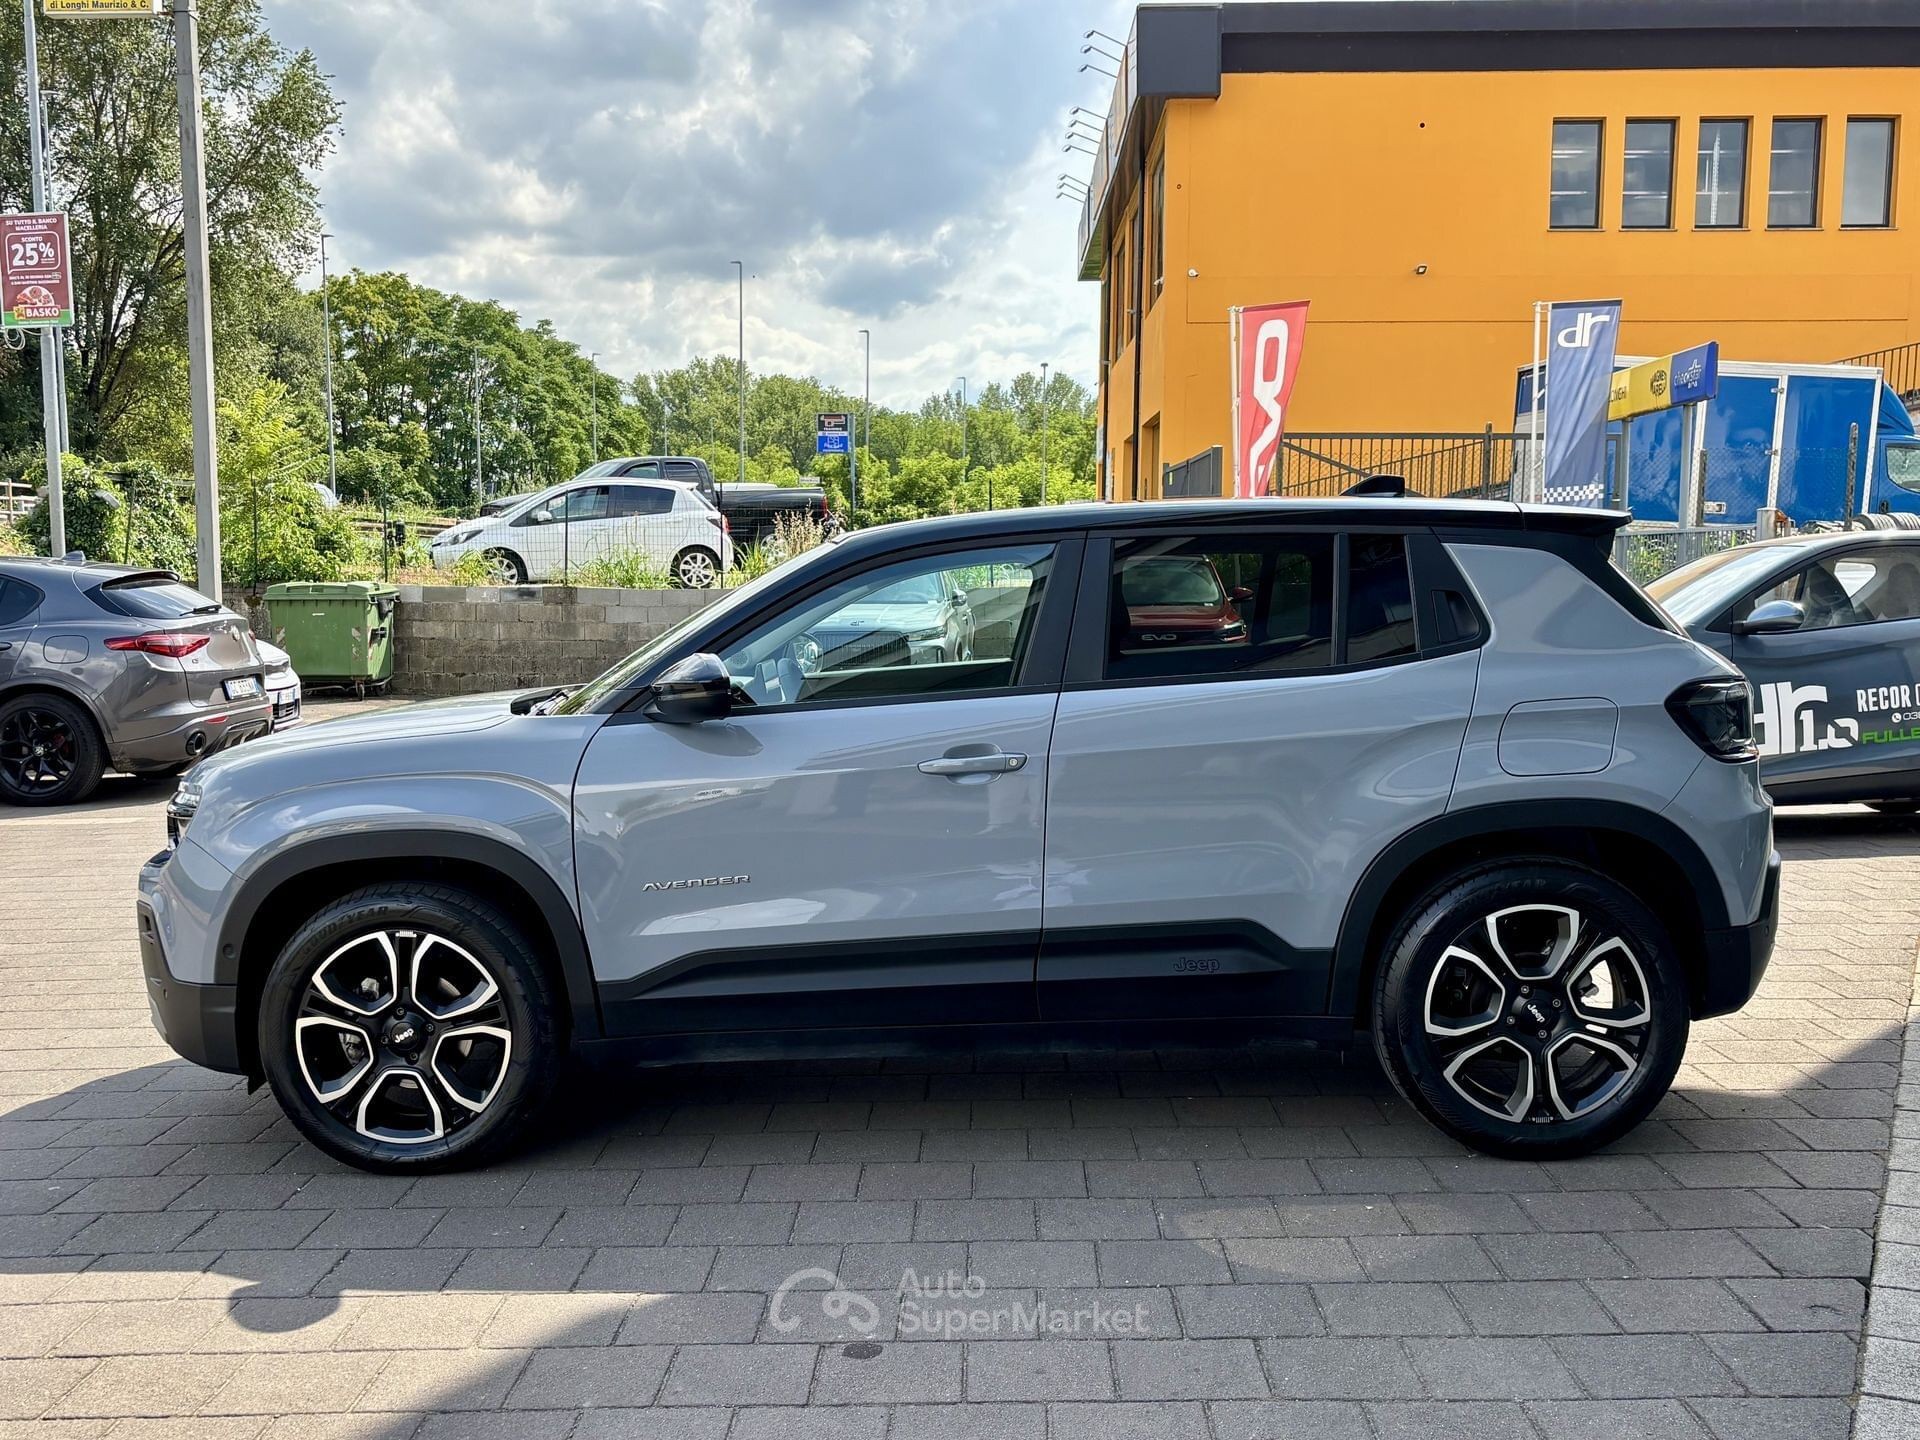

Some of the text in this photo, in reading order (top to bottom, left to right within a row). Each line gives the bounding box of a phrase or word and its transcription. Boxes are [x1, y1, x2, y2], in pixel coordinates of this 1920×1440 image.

[50, 0, 149, 10] di Longhi Maurizio & C.
[11, 242, 55, 267] 25%
[26, 307, 60, 318] BASKO
[1141, 633, 1177, 641] EVO
[1856, 685, 1912, 713] RECOR
[1903, 711, 1920, 721] 03
[642, 875, 751, 892] AVENGER
[1173, 957, 1220, 973] Jeep
[1527, 1004, 1545, 1023] Jeep
[394, 1028, 414, 1043] Jeep
